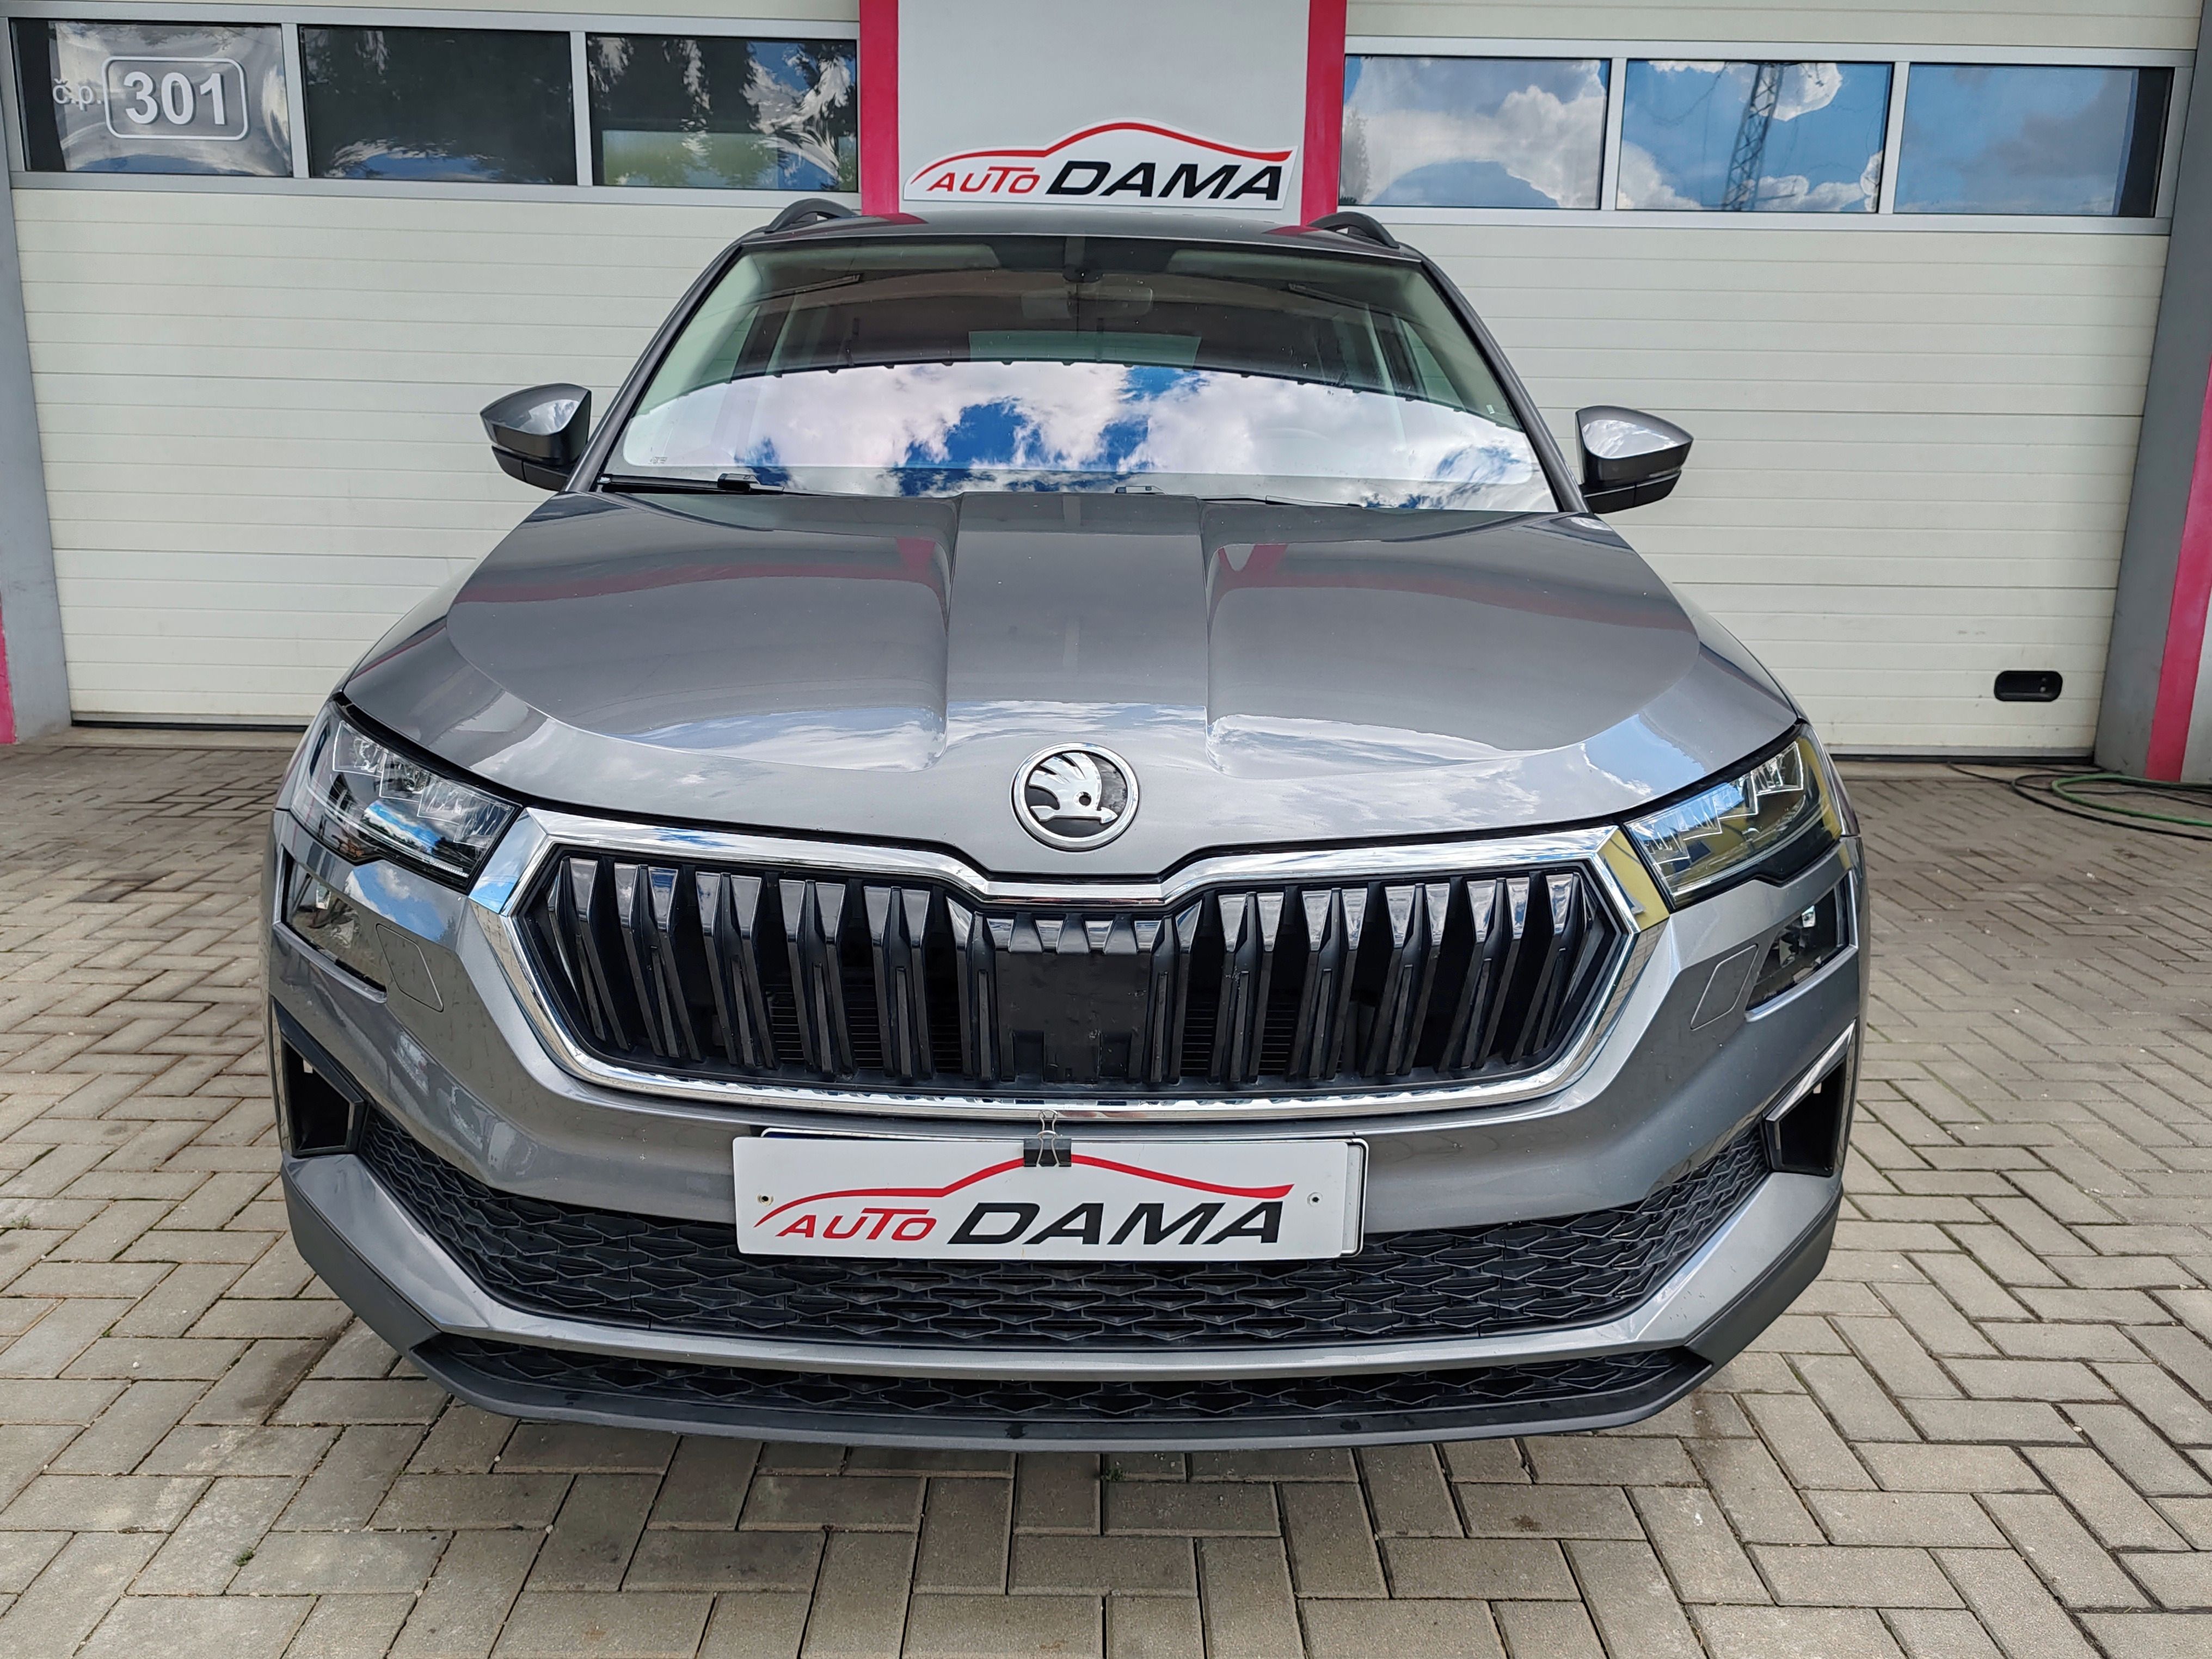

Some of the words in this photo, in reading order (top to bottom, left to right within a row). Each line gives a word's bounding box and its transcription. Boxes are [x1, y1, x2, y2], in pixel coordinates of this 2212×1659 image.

[52, 78, 103, 111] č.p.
[123, 71, 226, 126] 301
[925, 166, 1041, 194] AUTO
[1044, 159, 1283, 201] DAMA
[776, 1208, 937, 1241] AUTO
[947, 1201, 1284, 1245] DAMA
